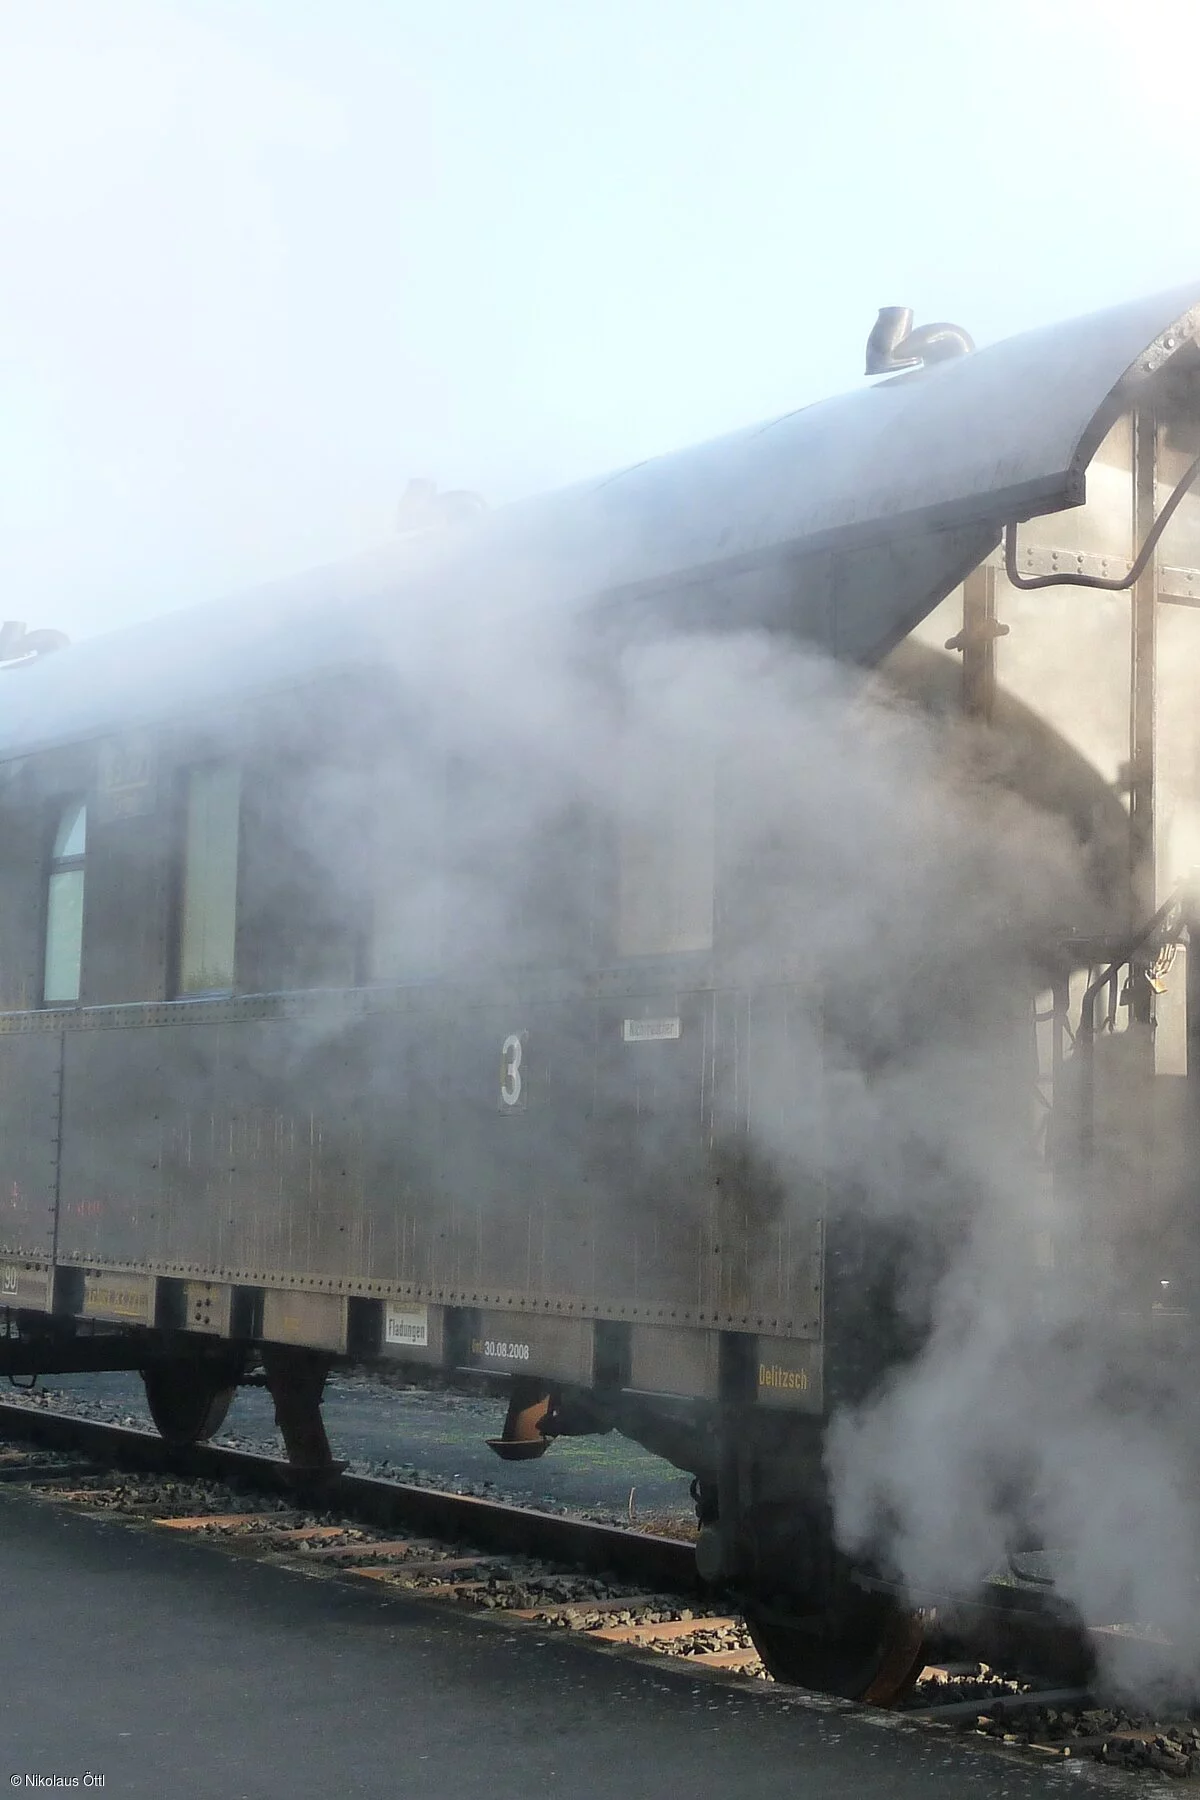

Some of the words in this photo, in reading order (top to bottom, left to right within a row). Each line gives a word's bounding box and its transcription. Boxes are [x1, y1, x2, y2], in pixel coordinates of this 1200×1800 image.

[501, 1034, 522, 1105] 3
[5, 1265, 17, 1290] 90
[388, 1318, 425, 1343] Fladungen
[759, 1363, 807, 1390] Delitzsch
